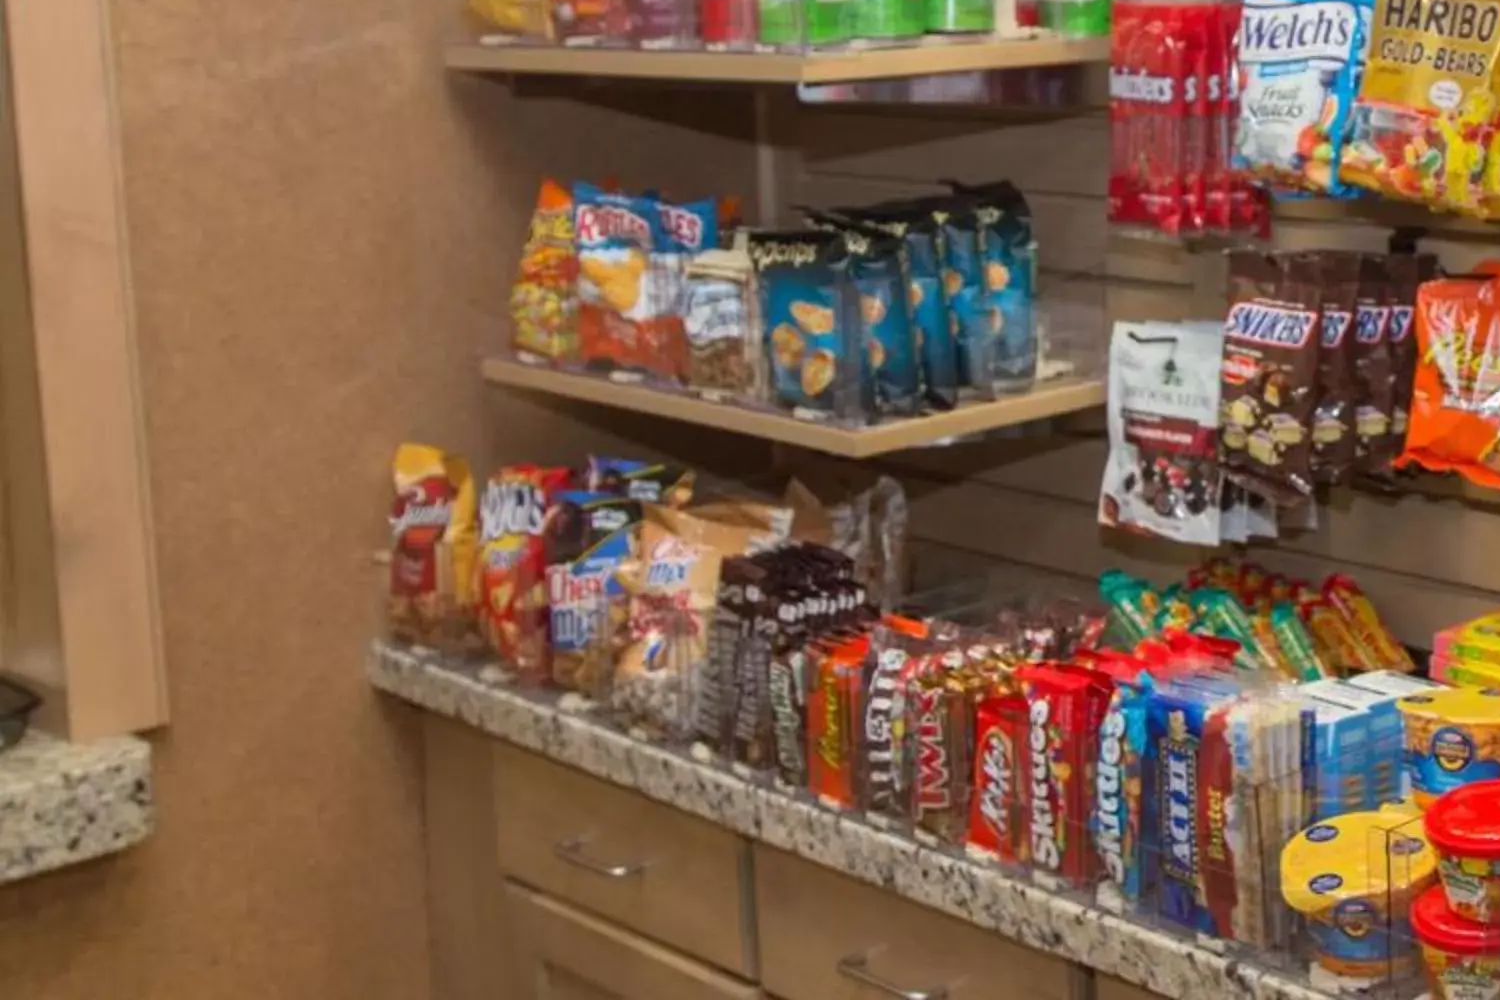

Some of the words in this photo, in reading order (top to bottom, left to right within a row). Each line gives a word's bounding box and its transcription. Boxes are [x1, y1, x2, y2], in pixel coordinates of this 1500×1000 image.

[1242, 9, 1350, 51] Welch's
[913, 688, 949, 808] TWIX
[1169, 798, 1191, 867] ACT
[1206, 785, 1225, 861] Butter
